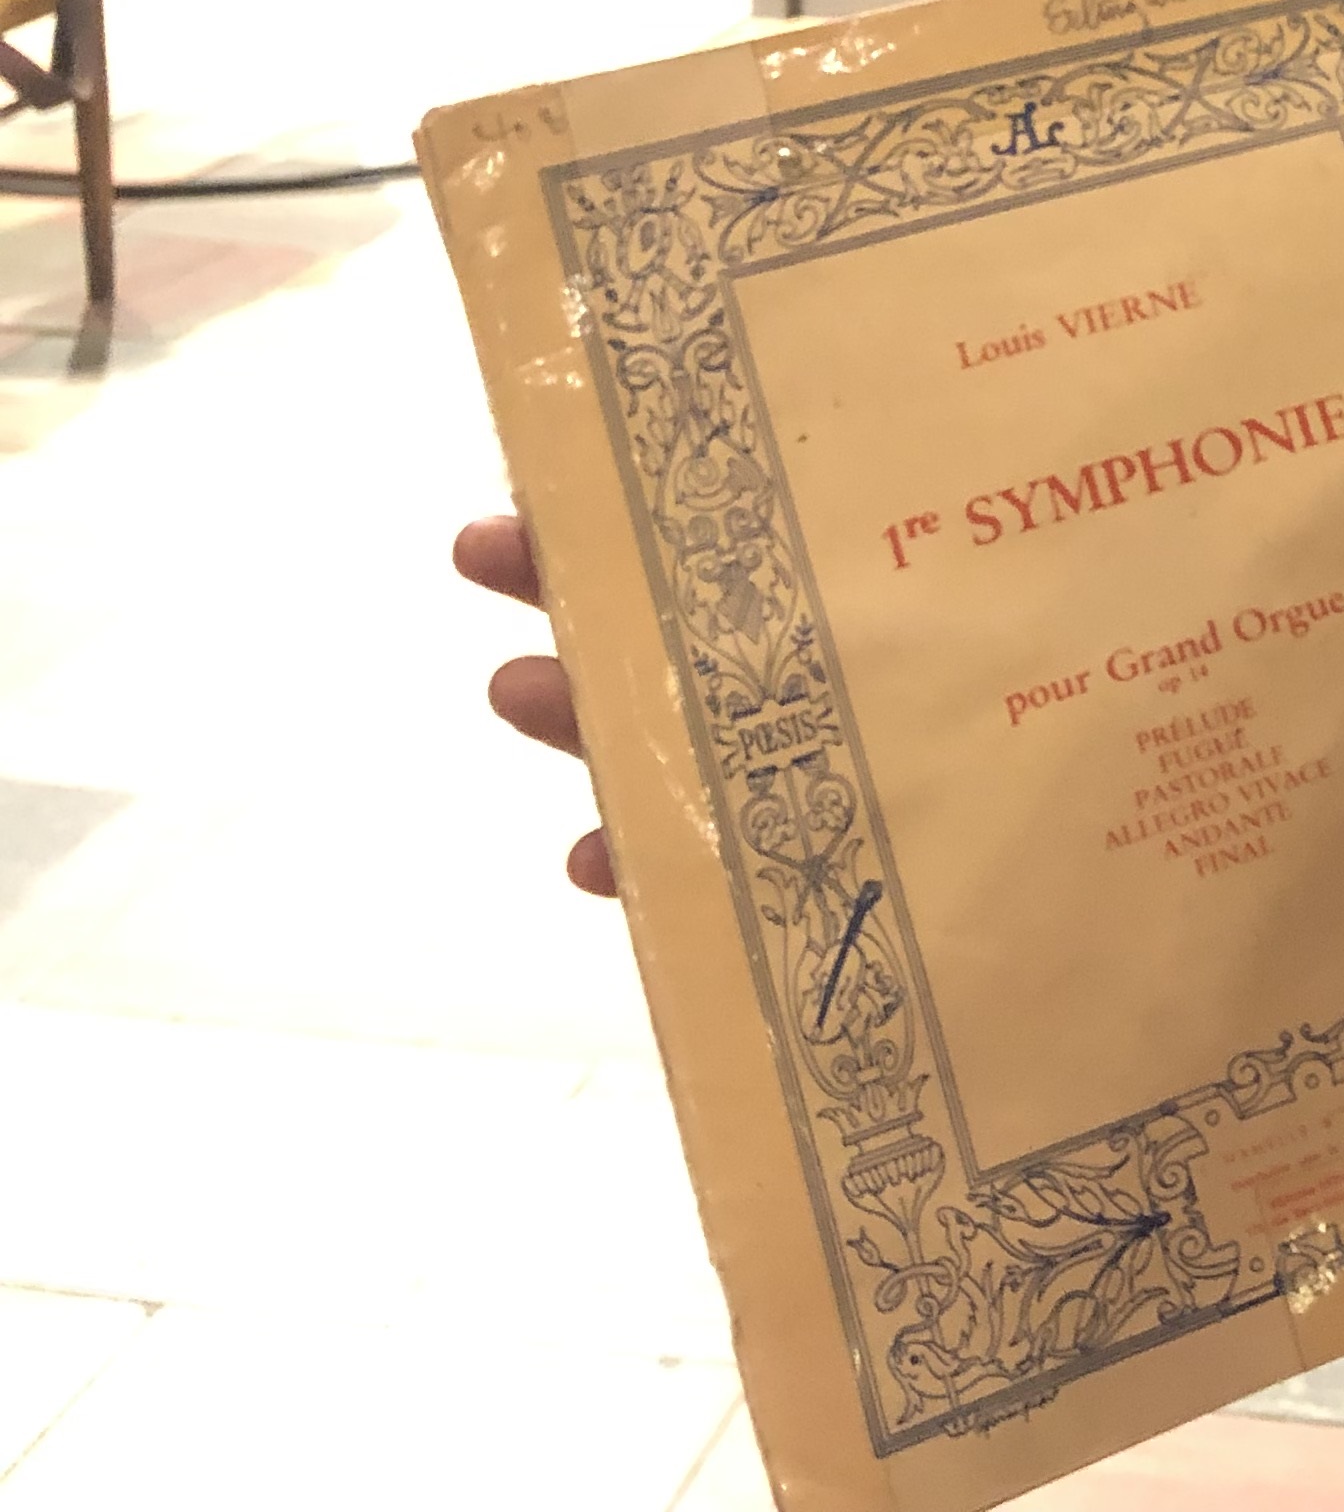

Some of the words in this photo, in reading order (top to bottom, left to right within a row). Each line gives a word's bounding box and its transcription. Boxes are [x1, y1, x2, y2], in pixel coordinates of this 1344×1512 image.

[955, 322, 1046, 370] Louis
[1055, 281, 1204, 339] VIERNE
[881, 511, 942, 571] 1re
[1004, 670, 1091, 727] pour
[1105, 619, 1223, 682] Grand
[1134, 745, 1283, 810] PASTORALE
[1158, 727, 1246, 774] FUGUE
[1106, 791, 1231, 850] ALLEGRO
[1237, 757, 1332, 802] VIVACE
[1164, 801, 1293, 861] ANDANTE
[1194, 835, 1274, 878] FINAL
